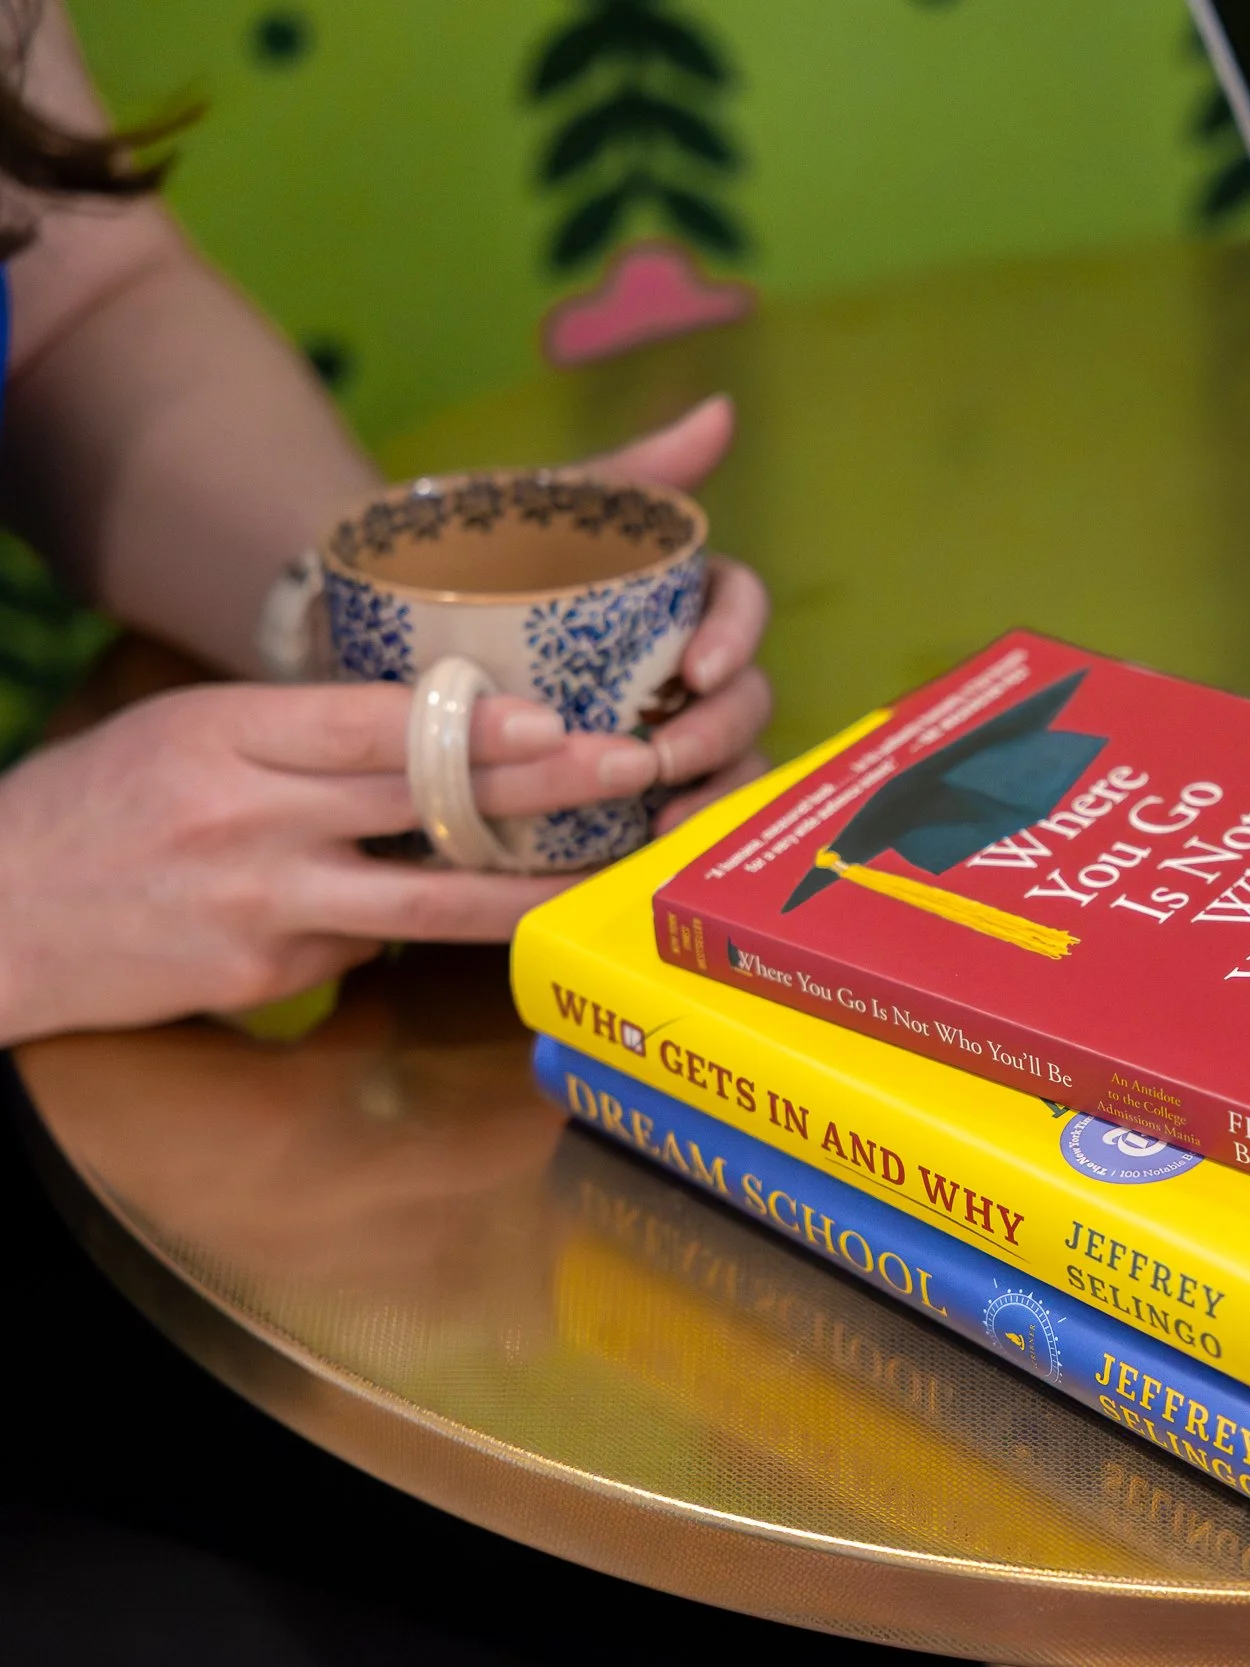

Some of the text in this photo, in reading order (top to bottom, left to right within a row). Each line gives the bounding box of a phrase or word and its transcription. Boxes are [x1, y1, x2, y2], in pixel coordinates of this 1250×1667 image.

[966, 766, 1149, 871] Where
[1024, 781, 1224, 907] You Go
[1111, 886, 1190, 924] Is
[738, 948, 792, 987] Where
[796, 971, 832, 1001] You
[837, 988, 866, 1013] Go
[871, 999, 888, 1021] Is
[893, 1006, 930, 1037] Not
[934, 1021, 983, 1055] Who
[1047, 1061, 1073, 1088] Be
[1097, 1100, 1161, 1132] Admissions
[1164, 1124, 1202, 1147] Mania
[1108, 1090, 1187, 1126] to the College
[1111, 1073, 1182, 1107] An Antidote
[659, 1039, 757, 1113] GETS
[767, 1090, 810, 1140] IN
[820, 1121, 905, 1186] AND
[918, 1165, 1025, 1246] WHY
[1120, 1159, 1186, 1178] 100 Notable
[564, 1071, 731, 1193] DREAM
[742, 1173, 948, 1317] SCHOOL
[1065, 1221, 1226, 1320] JEFFREY
[1066, 1264, 1222, 1359] SELINGO
